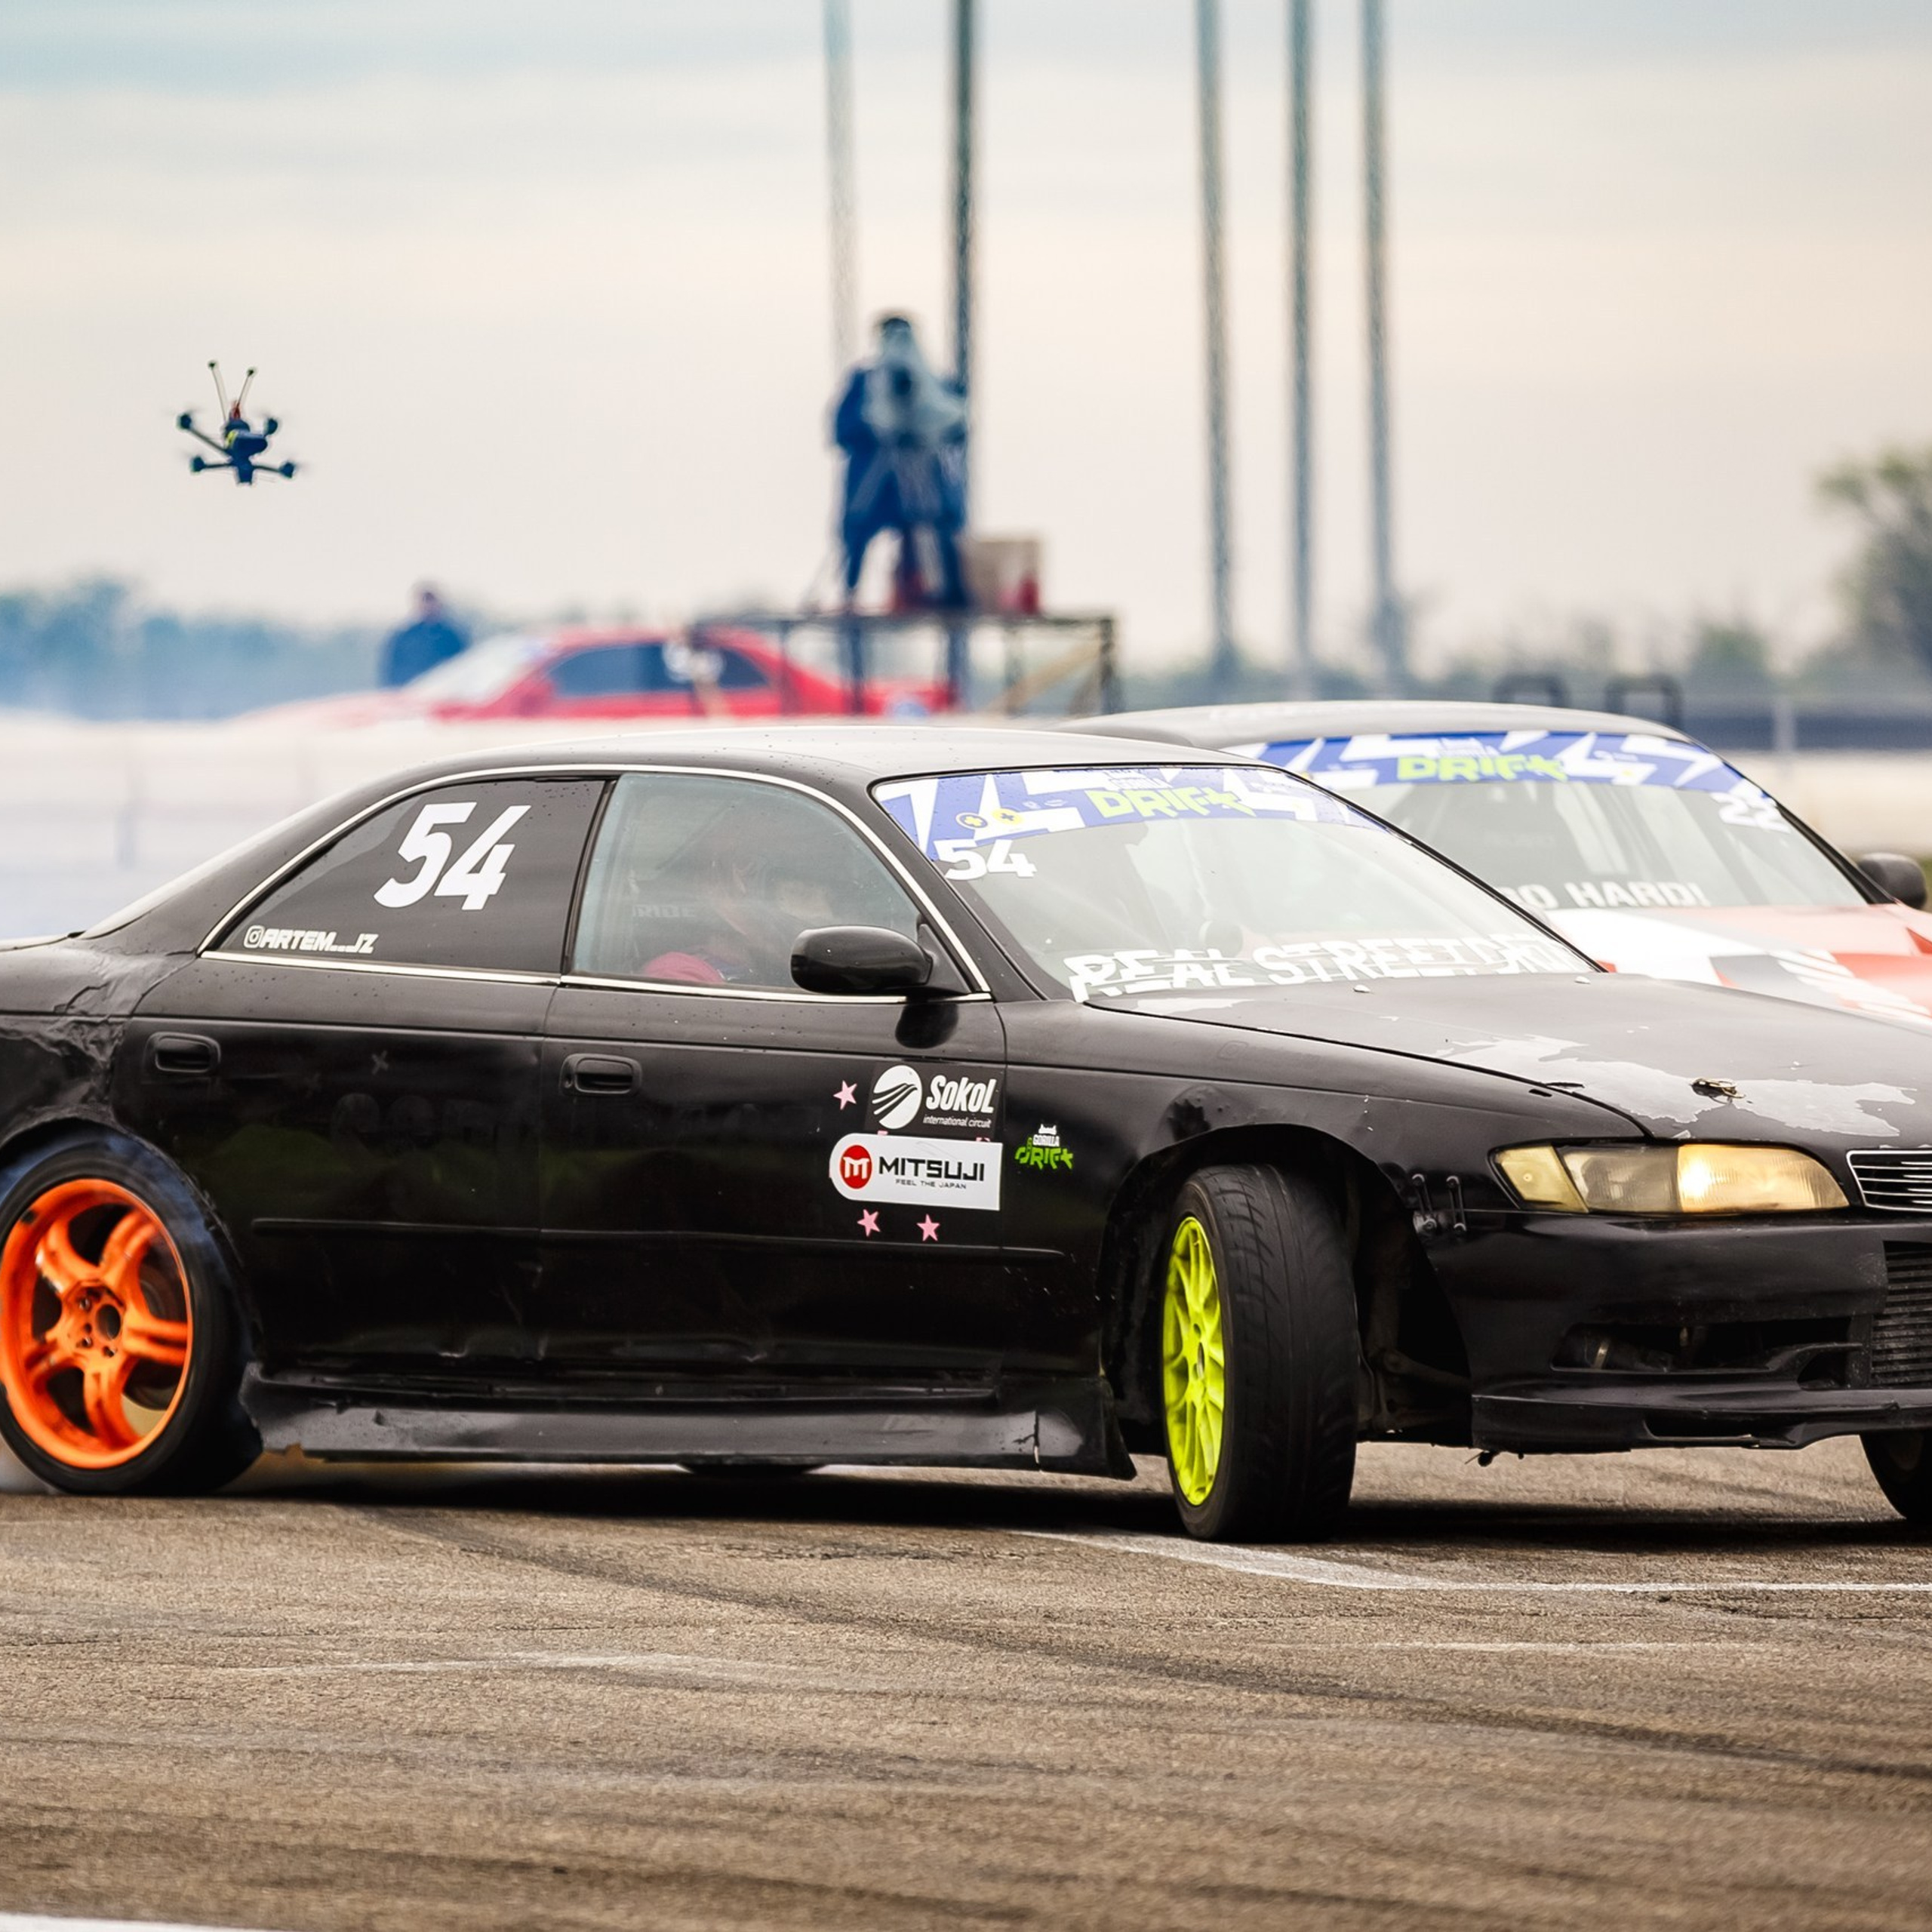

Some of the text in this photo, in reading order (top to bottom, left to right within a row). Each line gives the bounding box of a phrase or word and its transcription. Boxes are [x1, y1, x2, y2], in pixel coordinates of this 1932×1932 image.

[373, 801, 532, 911] 54
[935, 838, 1037, 880] 54
[1563, 880, 1711, 908] HARD!
[1063, 948, 1256, 1003] REAL
[923, 1114, 992, 1129] international circuit
[878, 1156, 985, 1182] MITSUJI
[895, 1178, 917, 1186] FEEL
[939, 1181, 967, 1190] JAPAN
